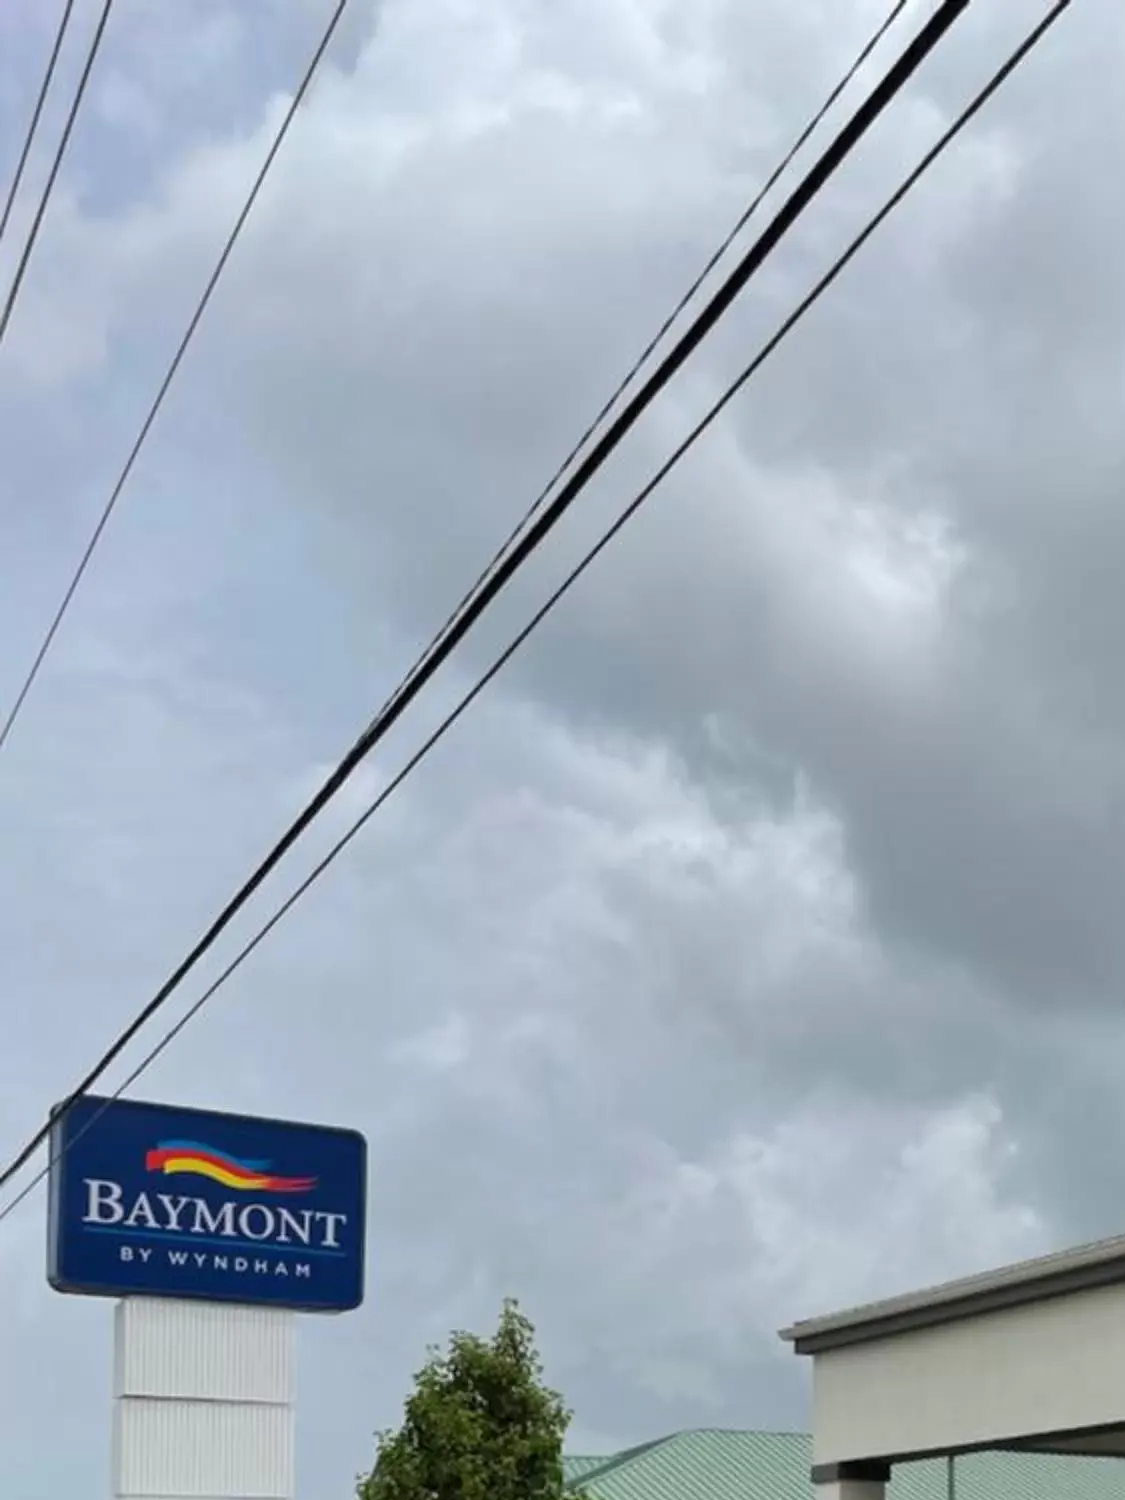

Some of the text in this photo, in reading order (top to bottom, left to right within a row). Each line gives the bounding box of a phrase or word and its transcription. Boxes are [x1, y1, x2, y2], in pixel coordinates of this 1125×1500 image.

[82, 1178, 348, 1248] BAYMONT
[120, 1247, 311, 1278] BY WYNDHAM
